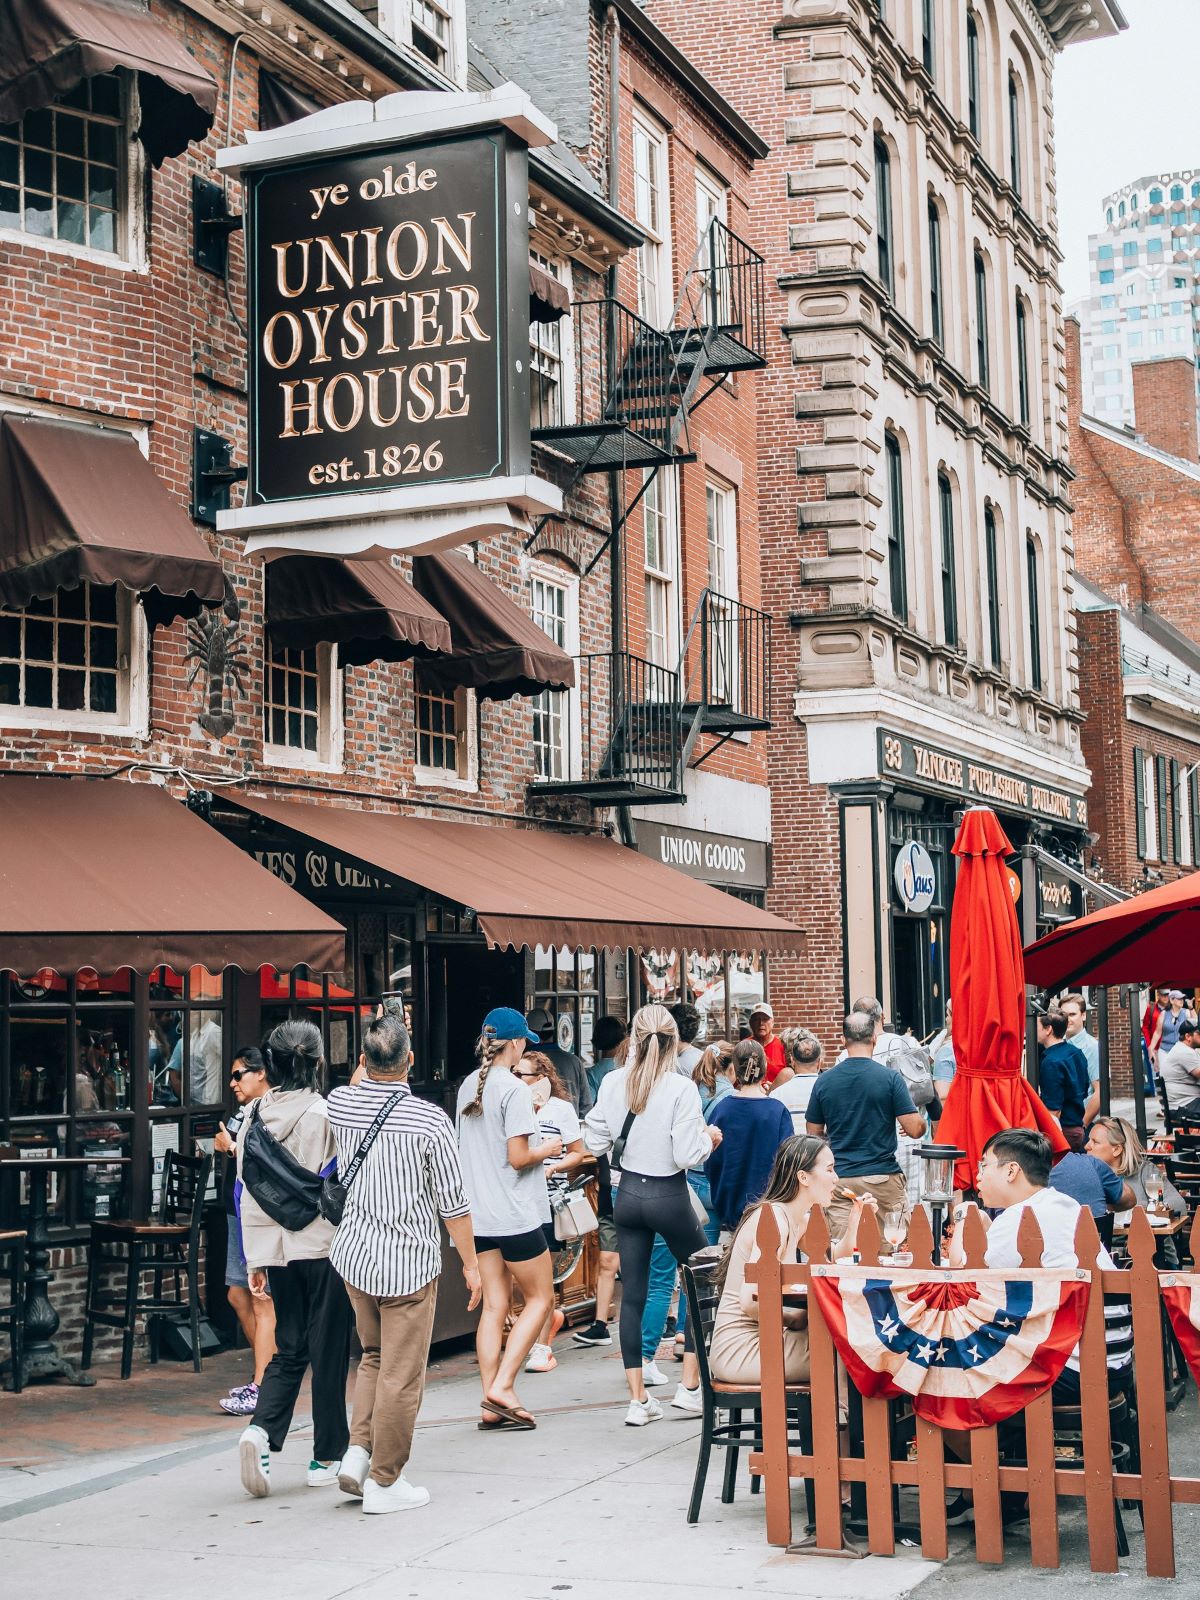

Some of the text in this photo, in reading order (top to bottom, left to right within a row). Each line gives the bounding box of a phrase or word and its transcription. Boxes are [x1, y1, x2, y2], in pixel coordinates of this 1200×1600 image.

[309, 161, 438, 220] ye olde
[271, 211, 477, 298] UNION
[262, 284, 491, 370] OYSTER
[278, 357, 470, 439] HOUSE
[884, 736, 1087, 824] 33 YANKEE PUBLISHING BUILDING 33
[305, 850, 328, 888] &
[660, 835, 746, 873] UNION GOODS
[904, 844, 933, 902] Saus
[341, 1091, 405, 1189] RMOUR UNDER ARMOUR
